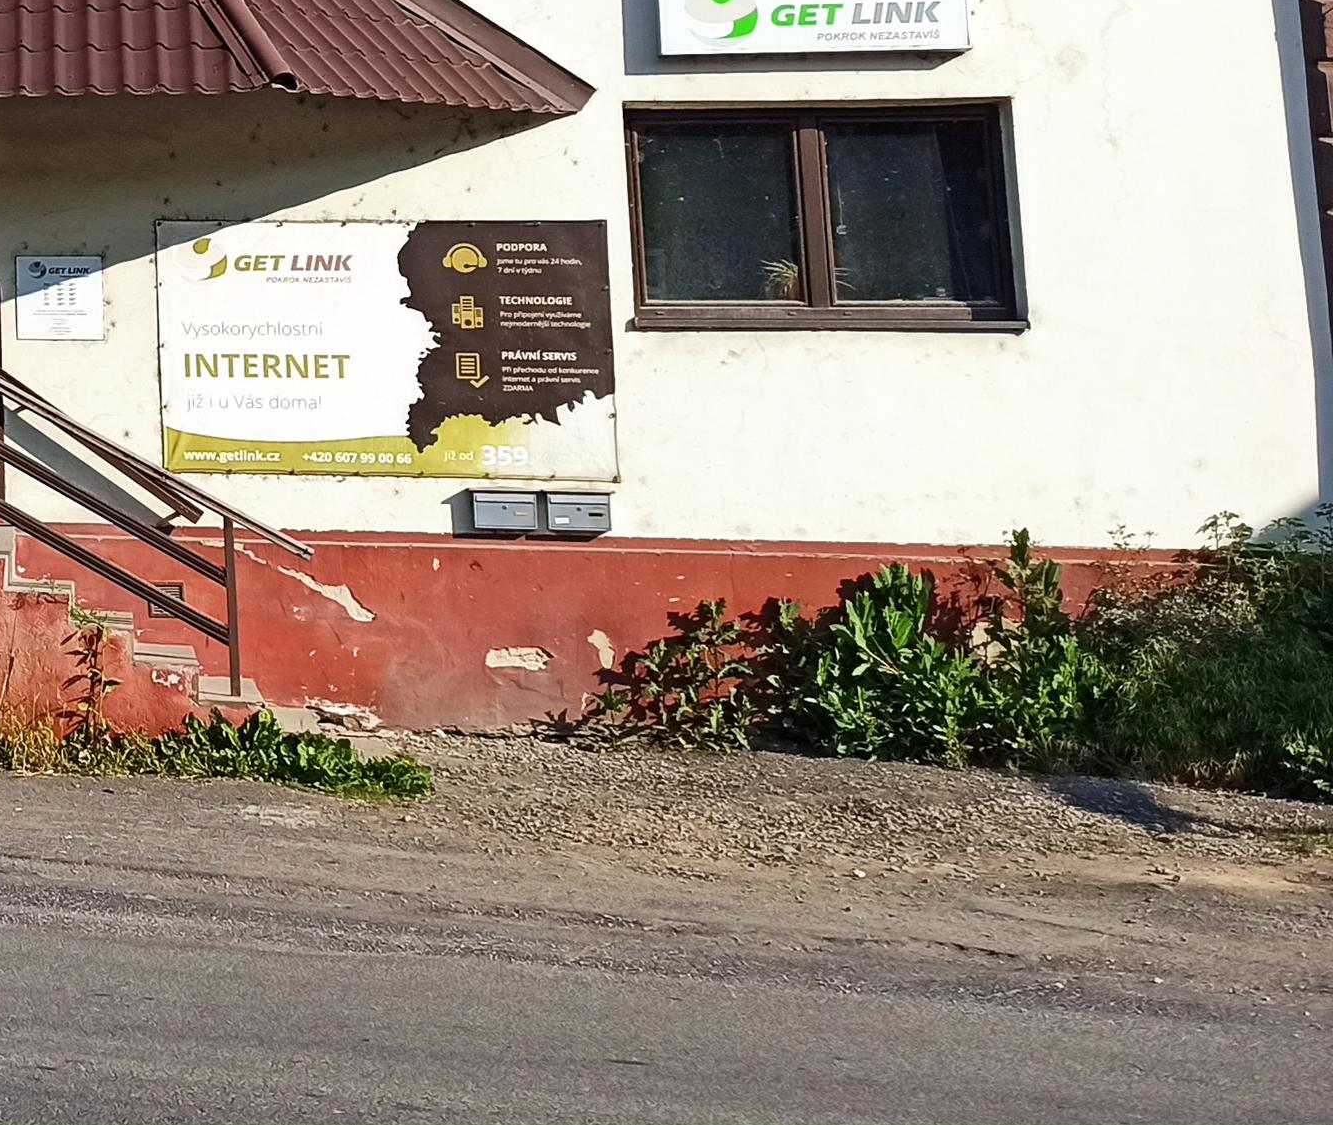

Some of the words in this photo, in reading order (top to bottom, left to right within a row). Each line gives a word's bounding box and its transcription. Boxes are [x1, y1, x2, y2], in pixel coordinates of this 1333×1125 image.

[770, 3, 845, 27] GET
[851, 1, 941, 25] LINK
[817, 32, 867, 42] POKROK
[496, 243, 548, 252] PODPORA
[233, 254, 286, 272] GET
[290, 254, 353, 272] LINK
[48, 267, 68, 275] GET
[68, 267, 91, 275] LINK
[499, 296, 573, 305] TECHNOLOGIE
[182, 321, 324, 340] Vysokorychlostní
[501, 349, 541, 360] PRÁVNÍ
[542, 351, 577, 361] SERVIS
[184, 353, 351, 379] INTERNET
[187, 394, 204, 413] již
[218, 398, 229, 409] u
[233, 394, 264, 409] Vás
[269, 394, 323, 410] doma!
[183, 450, 282, 464] www.getlink.cz
[302, 451, 332, 464] +420
[335, 451, 358, 464] 607
[360, 452, 376, 464] 99
[378, 452, 395, 464] 00
[396, 453, 413, 464] 66
[459, 450, 474, 461] od
[480, 444, 529, 466] 359
